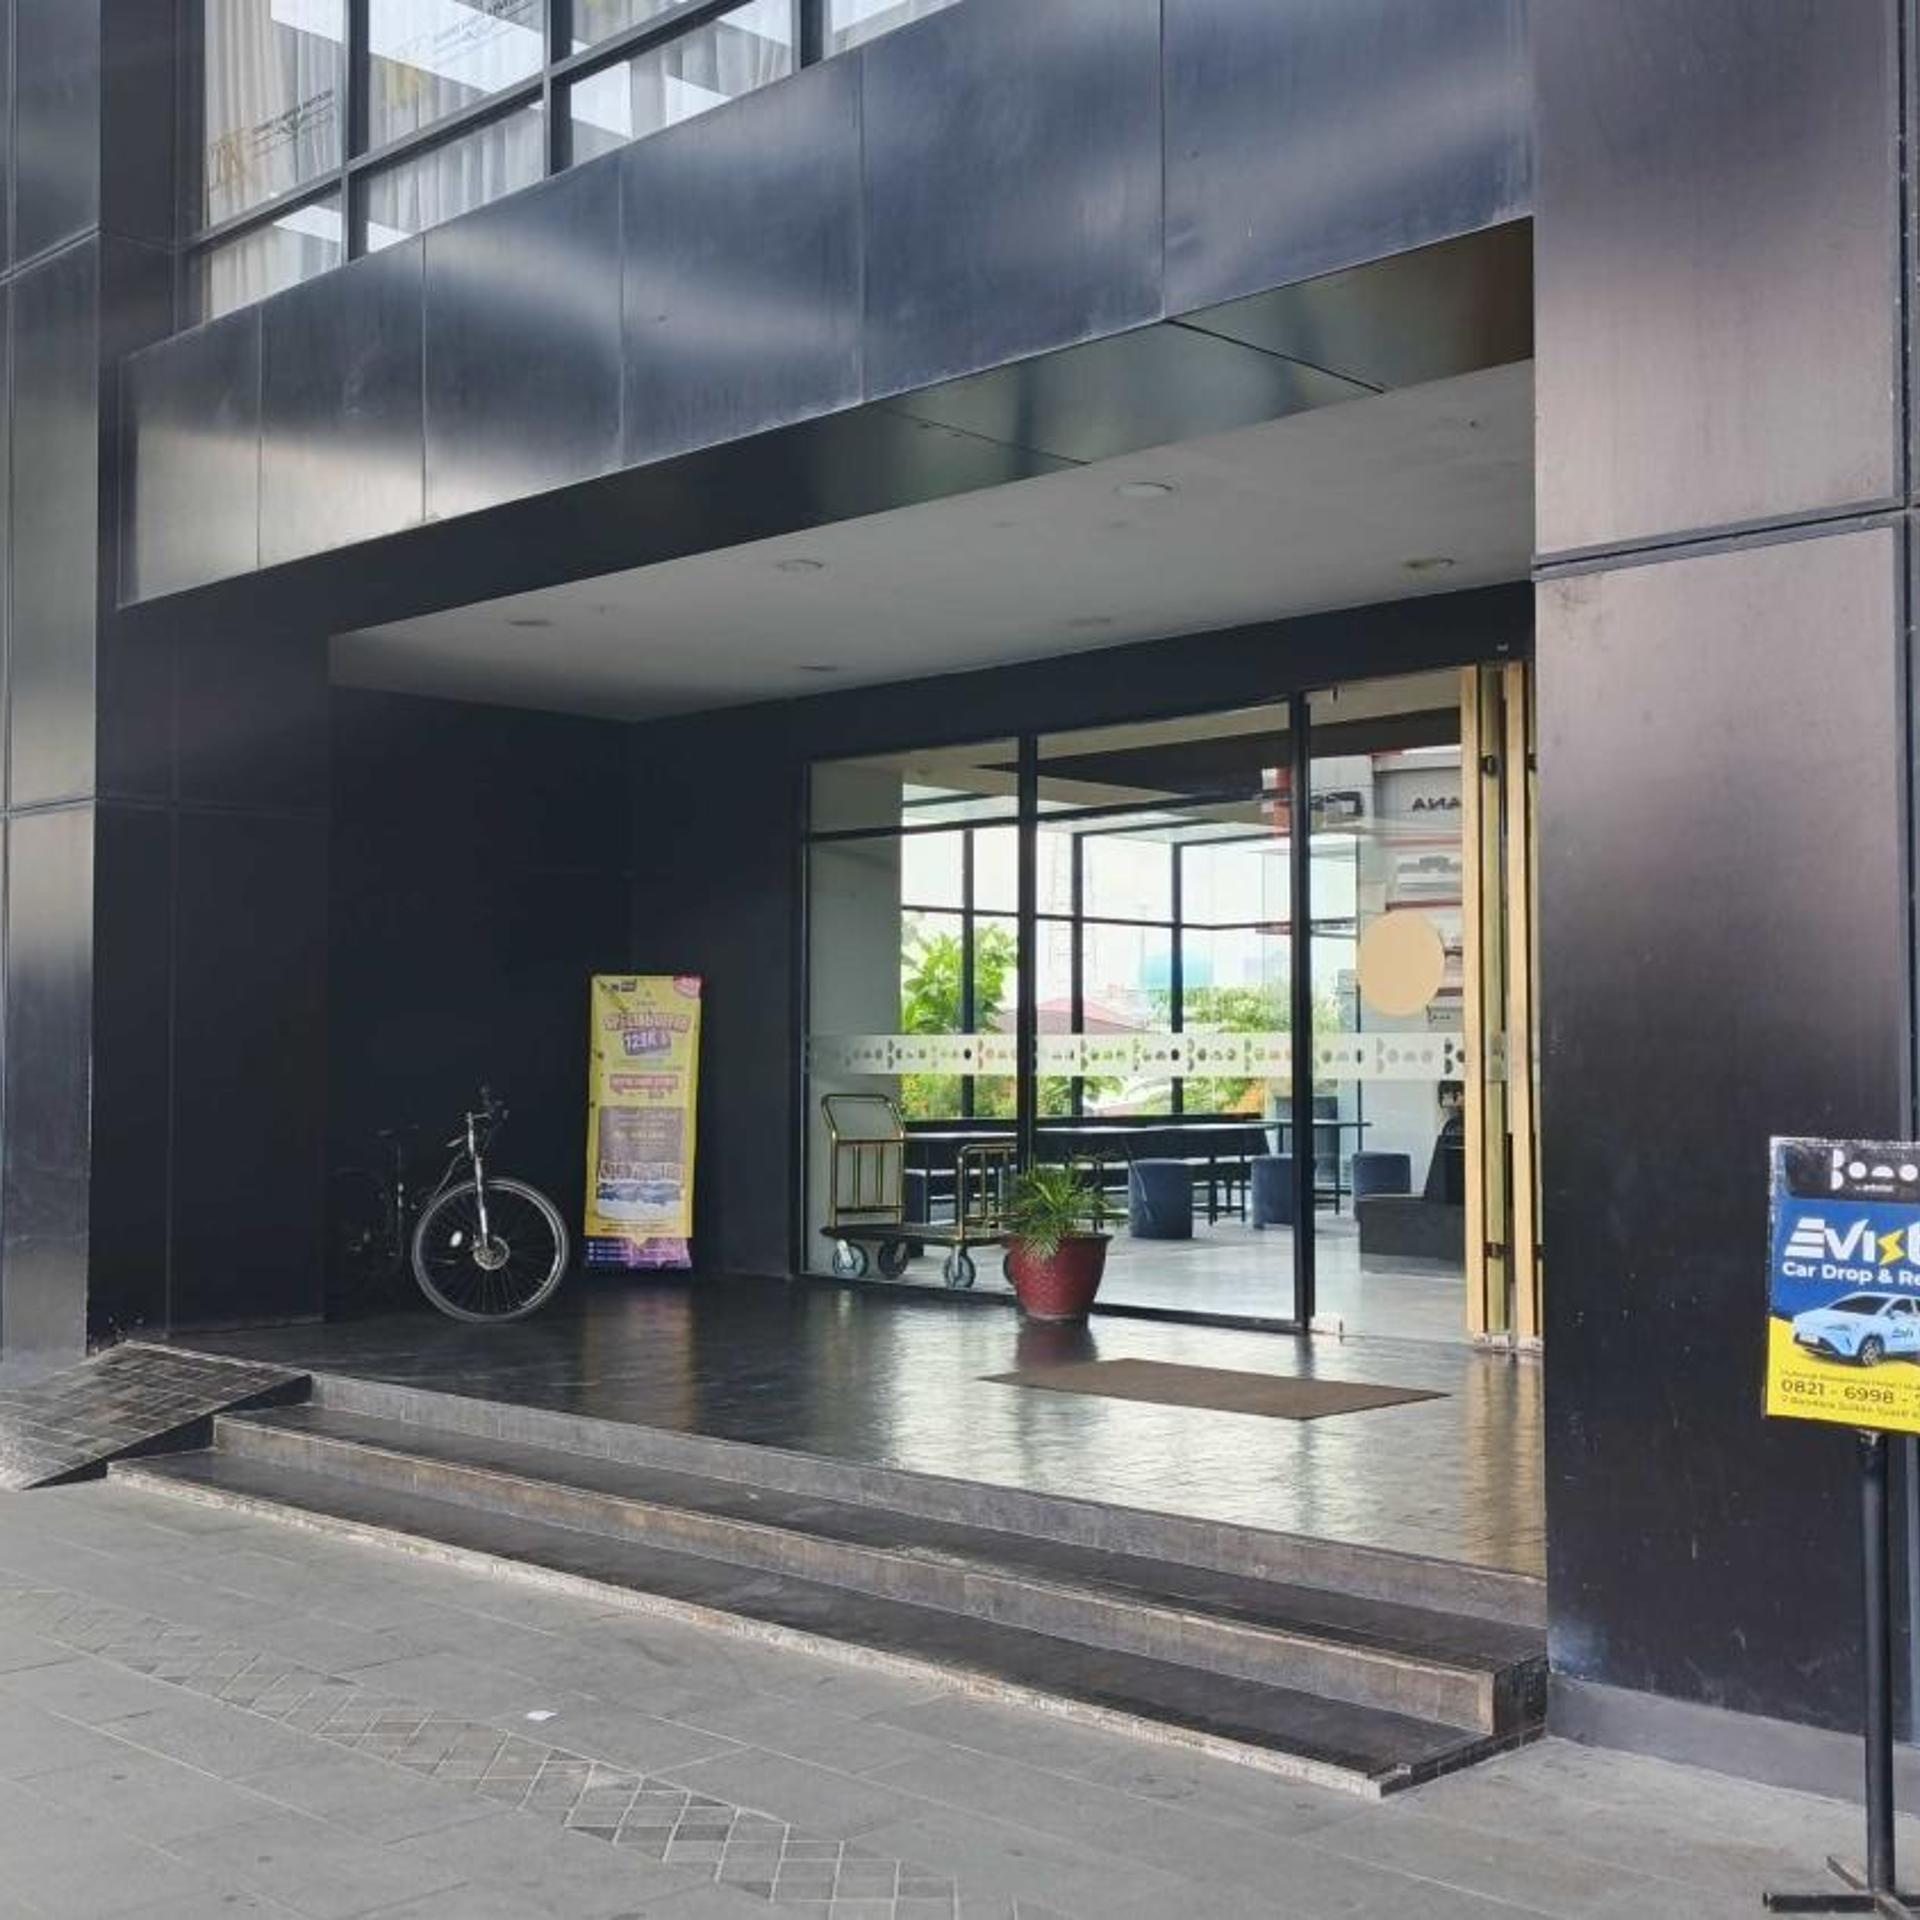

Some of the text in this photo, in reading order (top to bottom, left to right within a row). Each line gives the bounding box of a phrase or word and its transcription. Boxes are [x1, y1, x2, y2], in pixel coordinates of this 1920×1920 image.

[1782, 1261, 1817, 1278] Car
[1821, 1264, 1873, 1286] Drop
[1878, 1268, 1894, 1283] &
[1781, 1379, 1825, 1396] 0821
[1843, 1386, 1894, 1404] 6998
